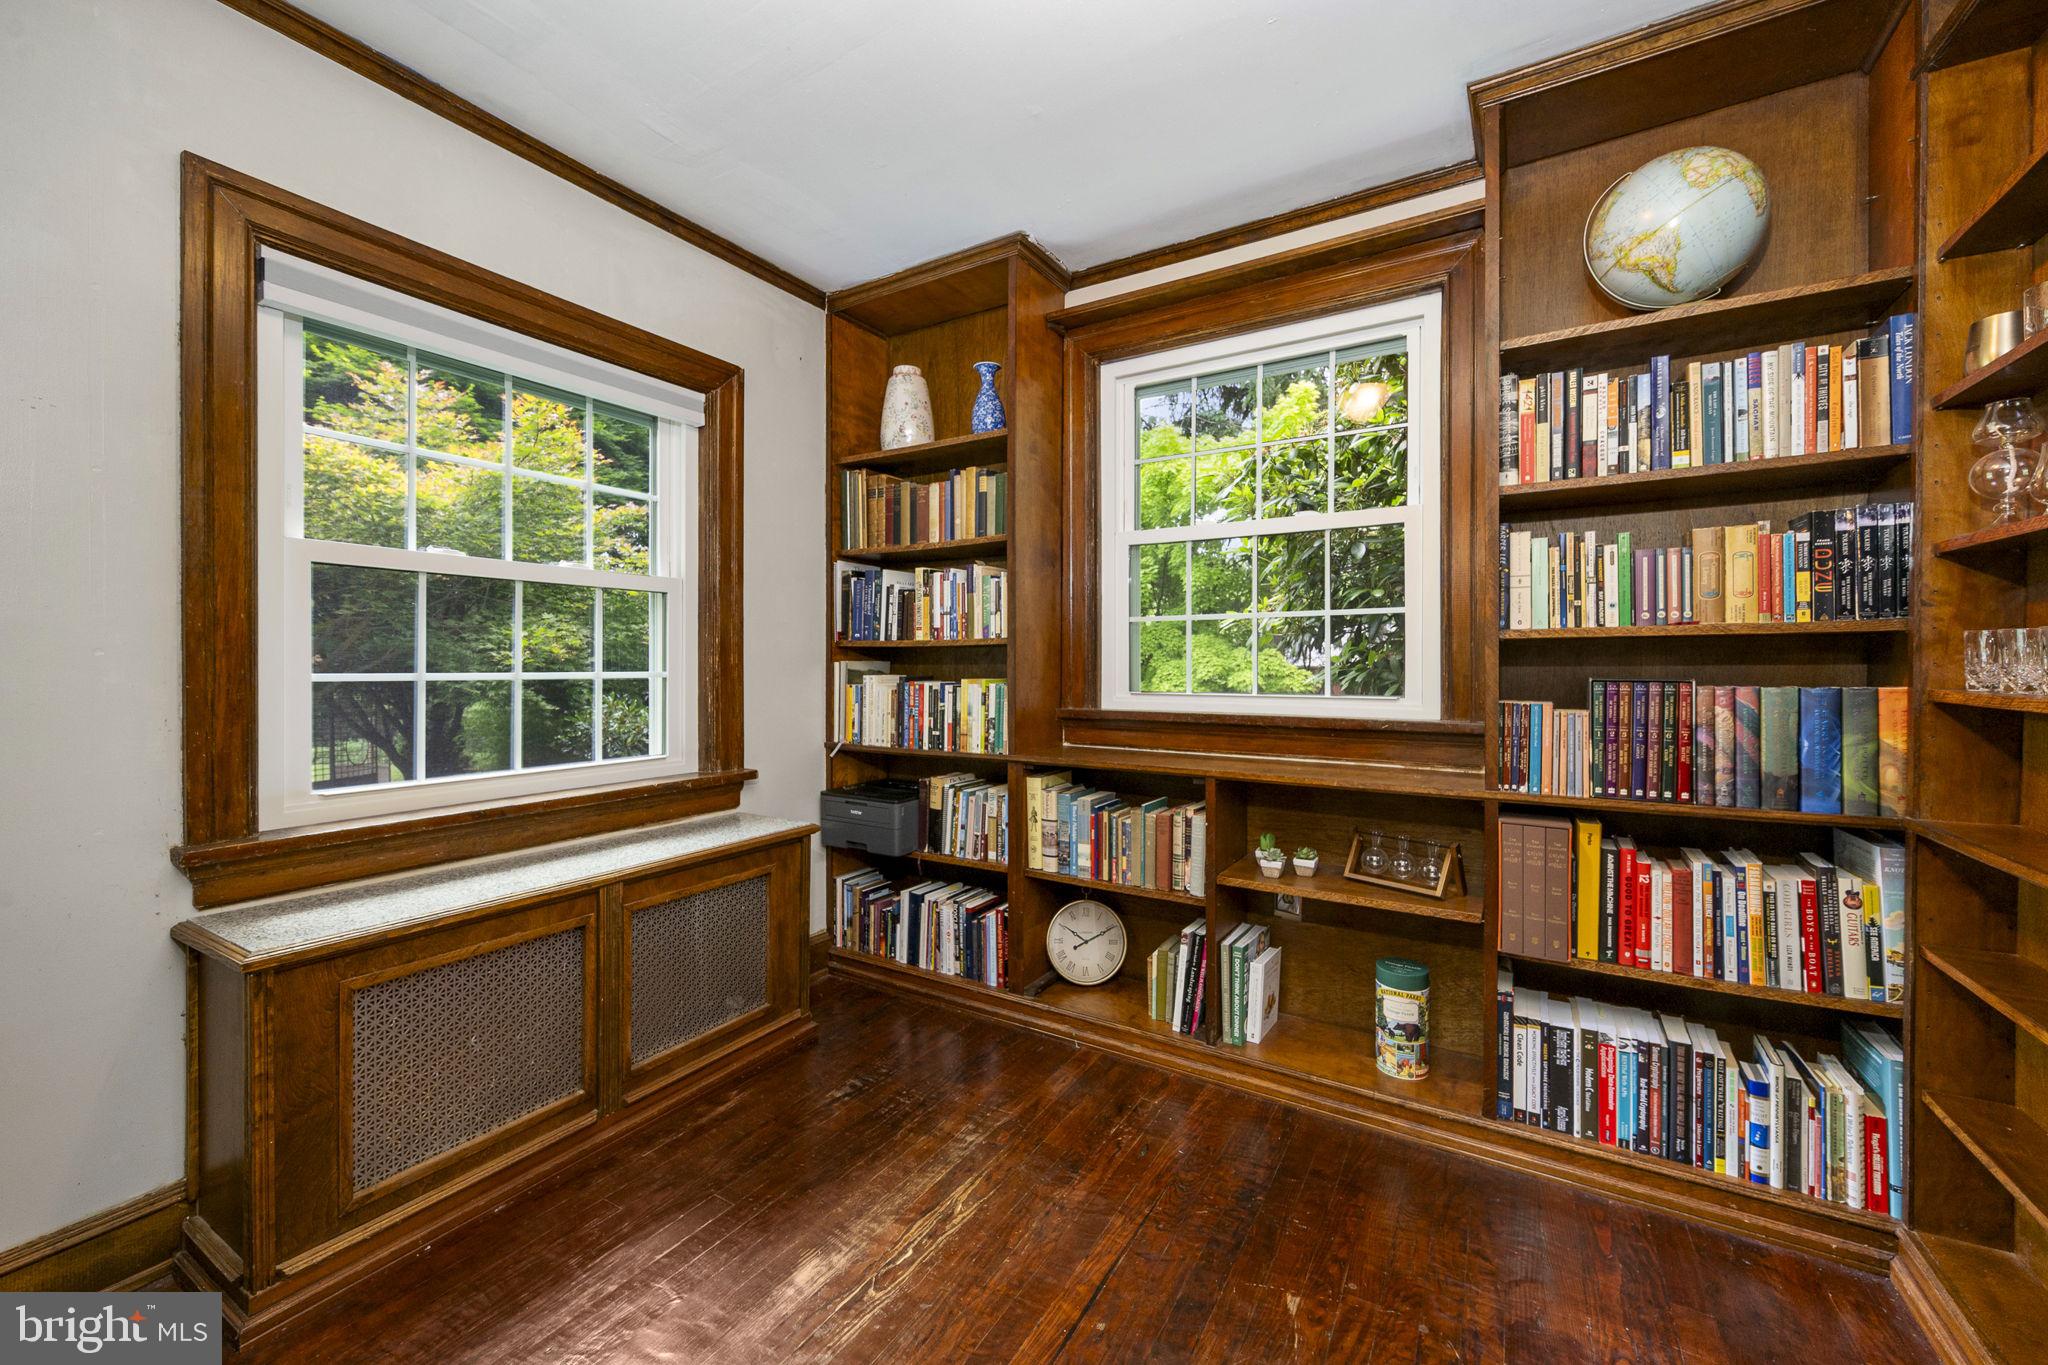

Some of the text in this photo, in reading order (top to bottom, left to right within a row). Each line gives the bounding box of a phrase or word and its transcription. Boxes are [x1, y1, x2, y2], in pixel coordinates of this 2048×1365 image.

[1895, 332, 1903, 346] Tales
[1904, 324, 1913, 384] JACK LONDON
[1818, 364, 1828, 410] CITY THIEVES
[1639, 874, 1649, 883] 12
[1750, 867, 1761, 916] FREAKONOMICS
[1625, 905, 1632, 916] TO
[1737, 891, 1746, 926] On Deadline
[1783, 884, 1792, 938] CODE GIRLS
[1847, 913, 1859, 946] GUITARS
[1870, 927, 1879, 961] SEE AMERICA
[1186, 967, 1196, 1003] Landscaping
[1381, 989, 1405, 997] NATIONAL
[1516, 1034, 1524, 1050] Clean
[1652, 1046, 1660, 1062] Serious
[1585, 1068, 1593, 1087] Modern
[1607, 1047, 1615, 1110] Designing Data-Intensive
[1650, 1062, 1659, 1089] Cryptography
[1639, 1078, 1647, 1130] Real-World Cryptography
[1872, 1133, 1881, 1153] Roget's
